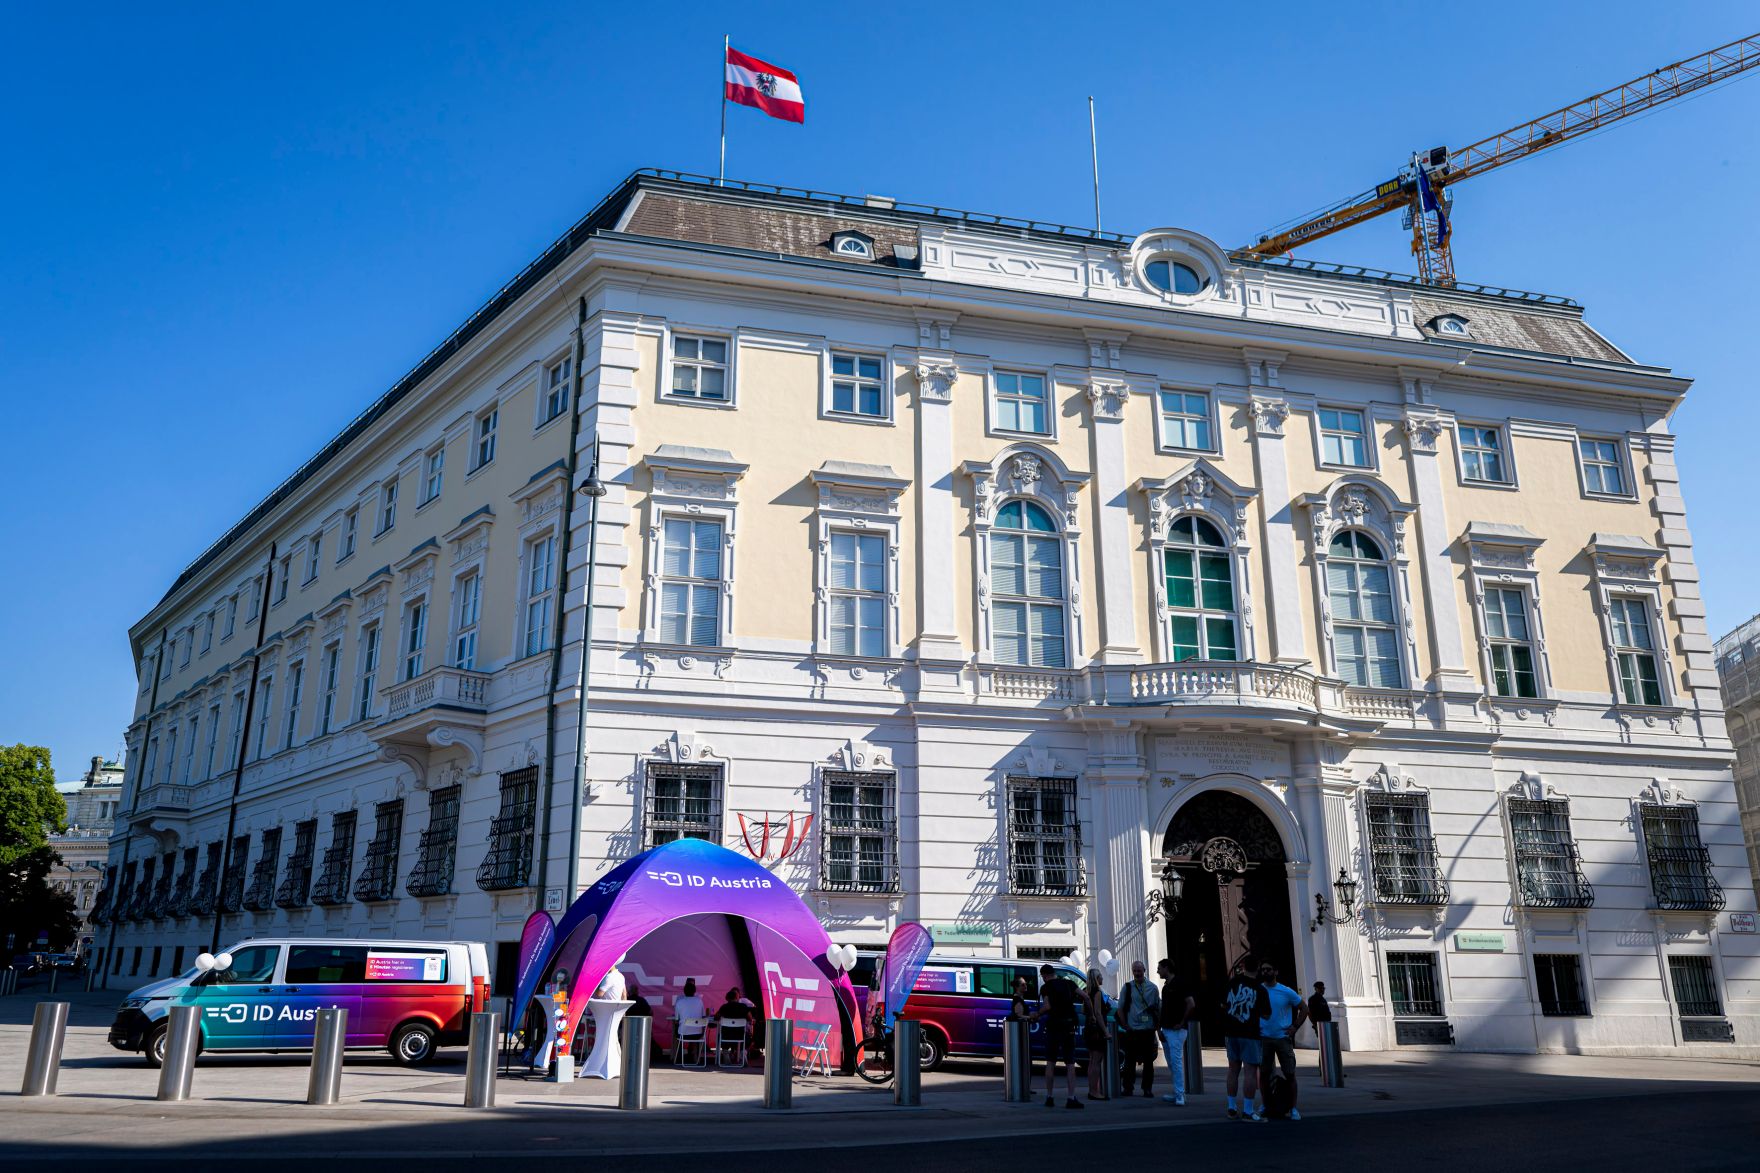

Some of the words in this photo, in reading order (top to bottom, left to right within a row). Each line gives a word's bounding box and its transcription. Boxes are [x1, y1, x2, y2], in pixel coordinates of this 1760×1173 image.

[1290, 218, 1333, 238] LIEBHERR
[687, 874, 705, 886] ID
[710, 876, 772, 888] Austria
[253, 1005, 274, 1021] ID
